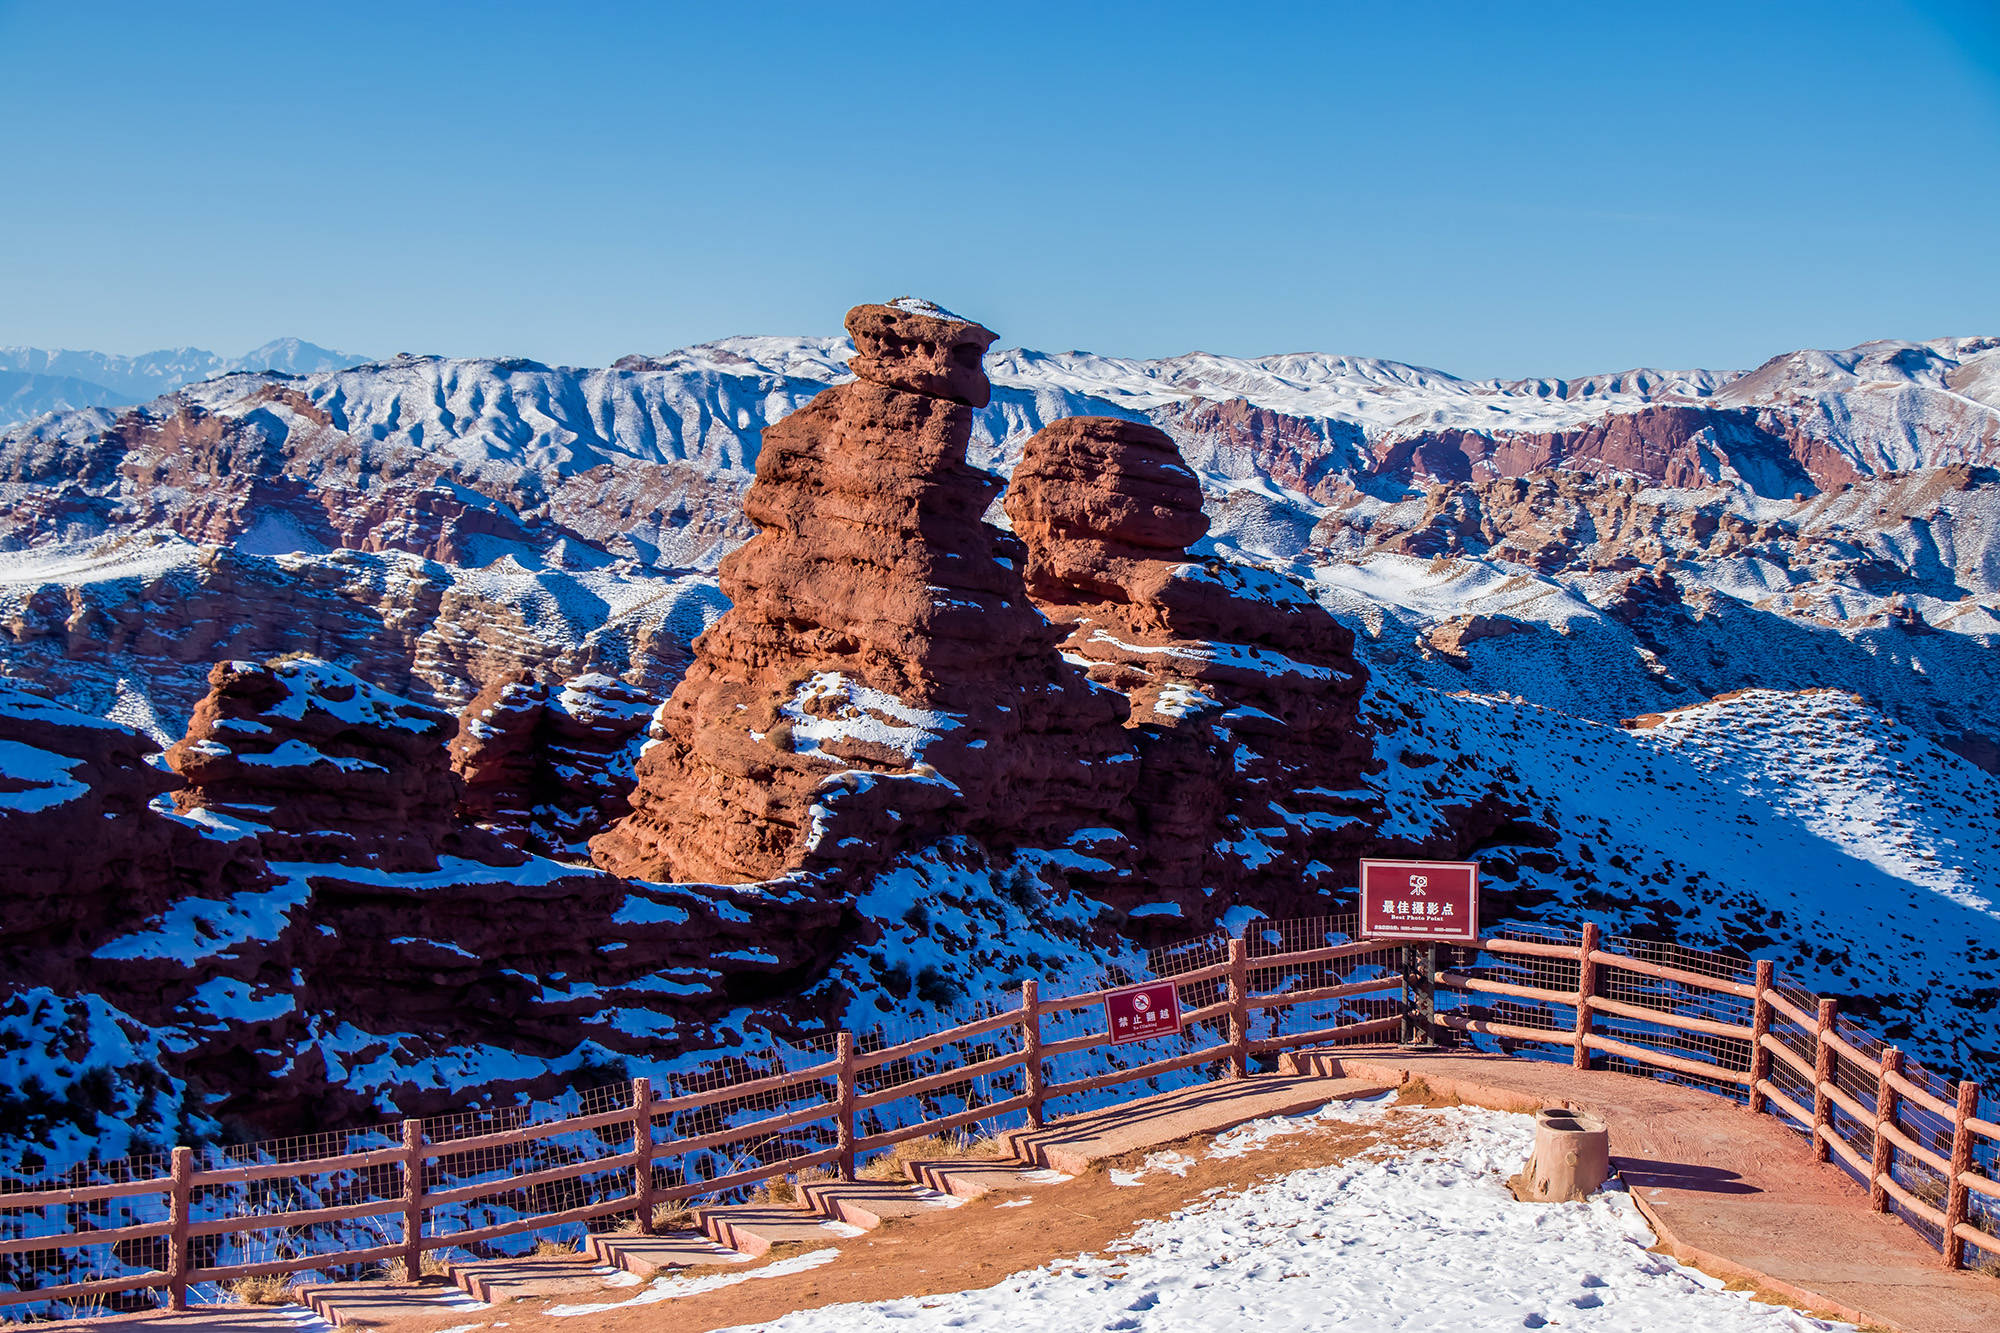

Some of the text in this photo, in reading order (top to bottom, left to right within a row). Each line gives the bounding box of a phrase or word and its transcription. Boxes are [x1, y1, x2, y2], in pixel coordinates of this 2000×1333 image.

[1382, 900, 1454, 916] 最佳摄影点
[1118, 1008, 1170, 1028] 禁止翻越
